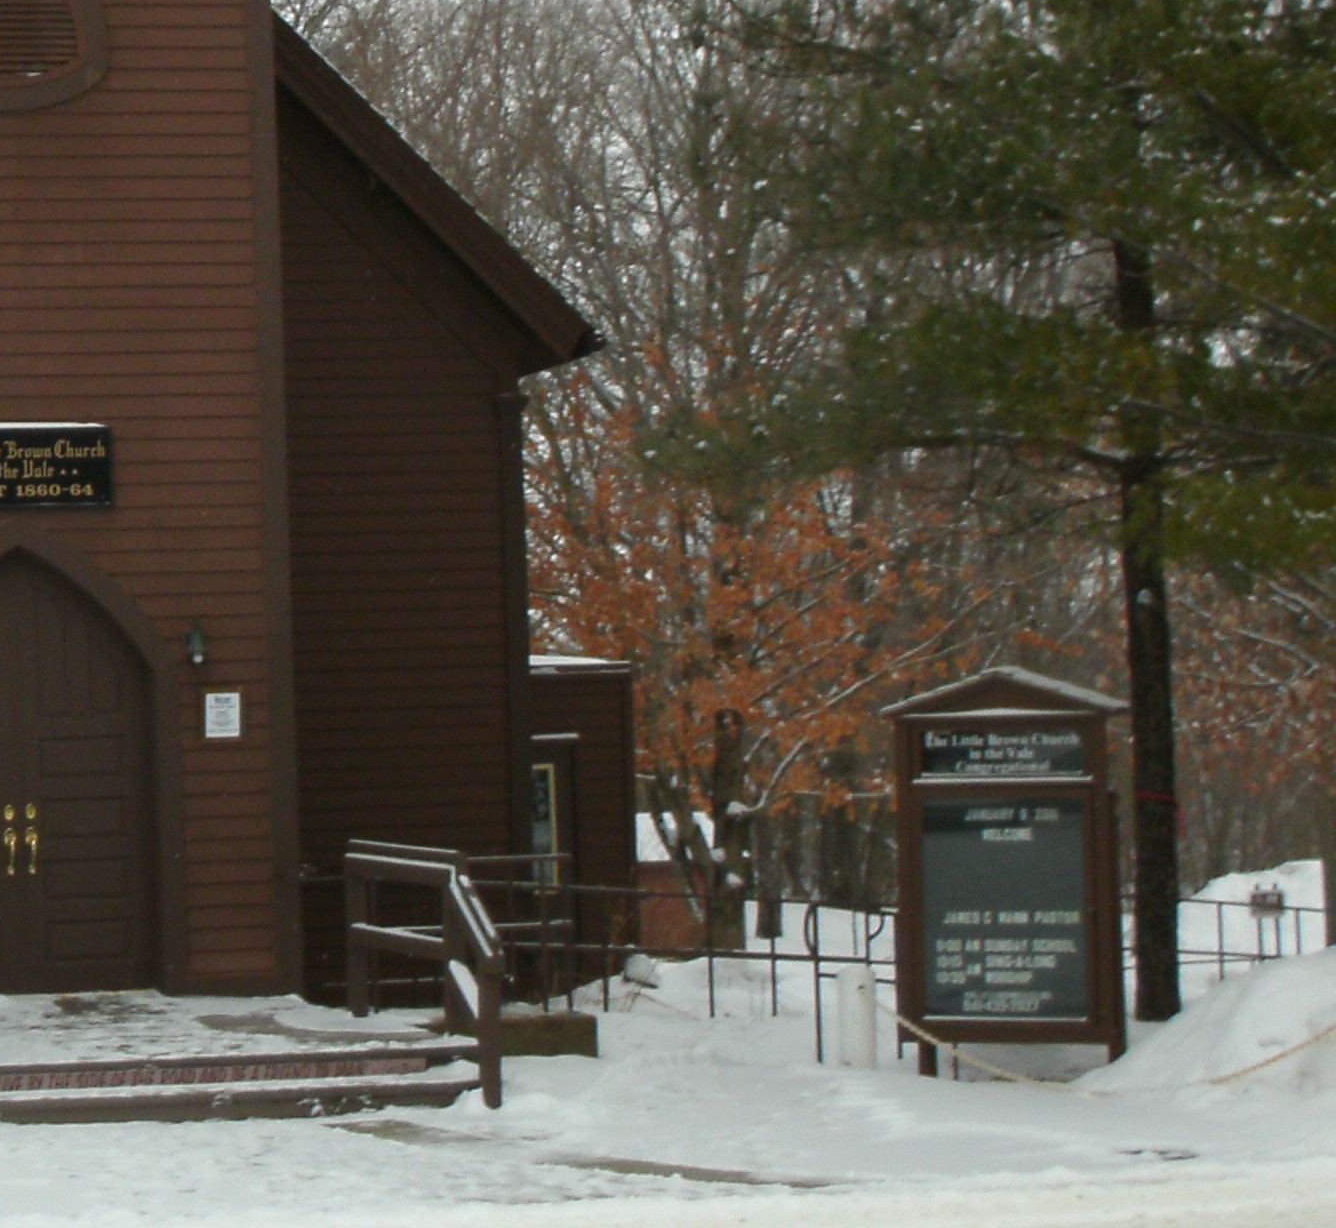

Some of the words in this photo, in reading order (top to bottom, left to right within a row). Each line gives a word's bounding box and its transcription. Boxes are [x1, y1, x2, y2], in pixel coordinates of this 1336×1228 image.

[4, 440, 52, 458] Brown
[54, 438, 106, 457] Church
[22, 460, 55, 479] Vale
[16, 483, 93, 496] 1860-64
[925, 731, 948, 748] The
[951, 734, 985, 746] Little
[987, 733, 1029, 746] Brown
[1031, 732, 1080, 746] Church
[968, 748, 982, 759] in
[984, 747, 1003, 759] the
[982, 828, 1033, 841] WELCOME
[1034, 911, 1080, 924] PASTOR
[1032, 939, 1076, 952] SCHOOL
